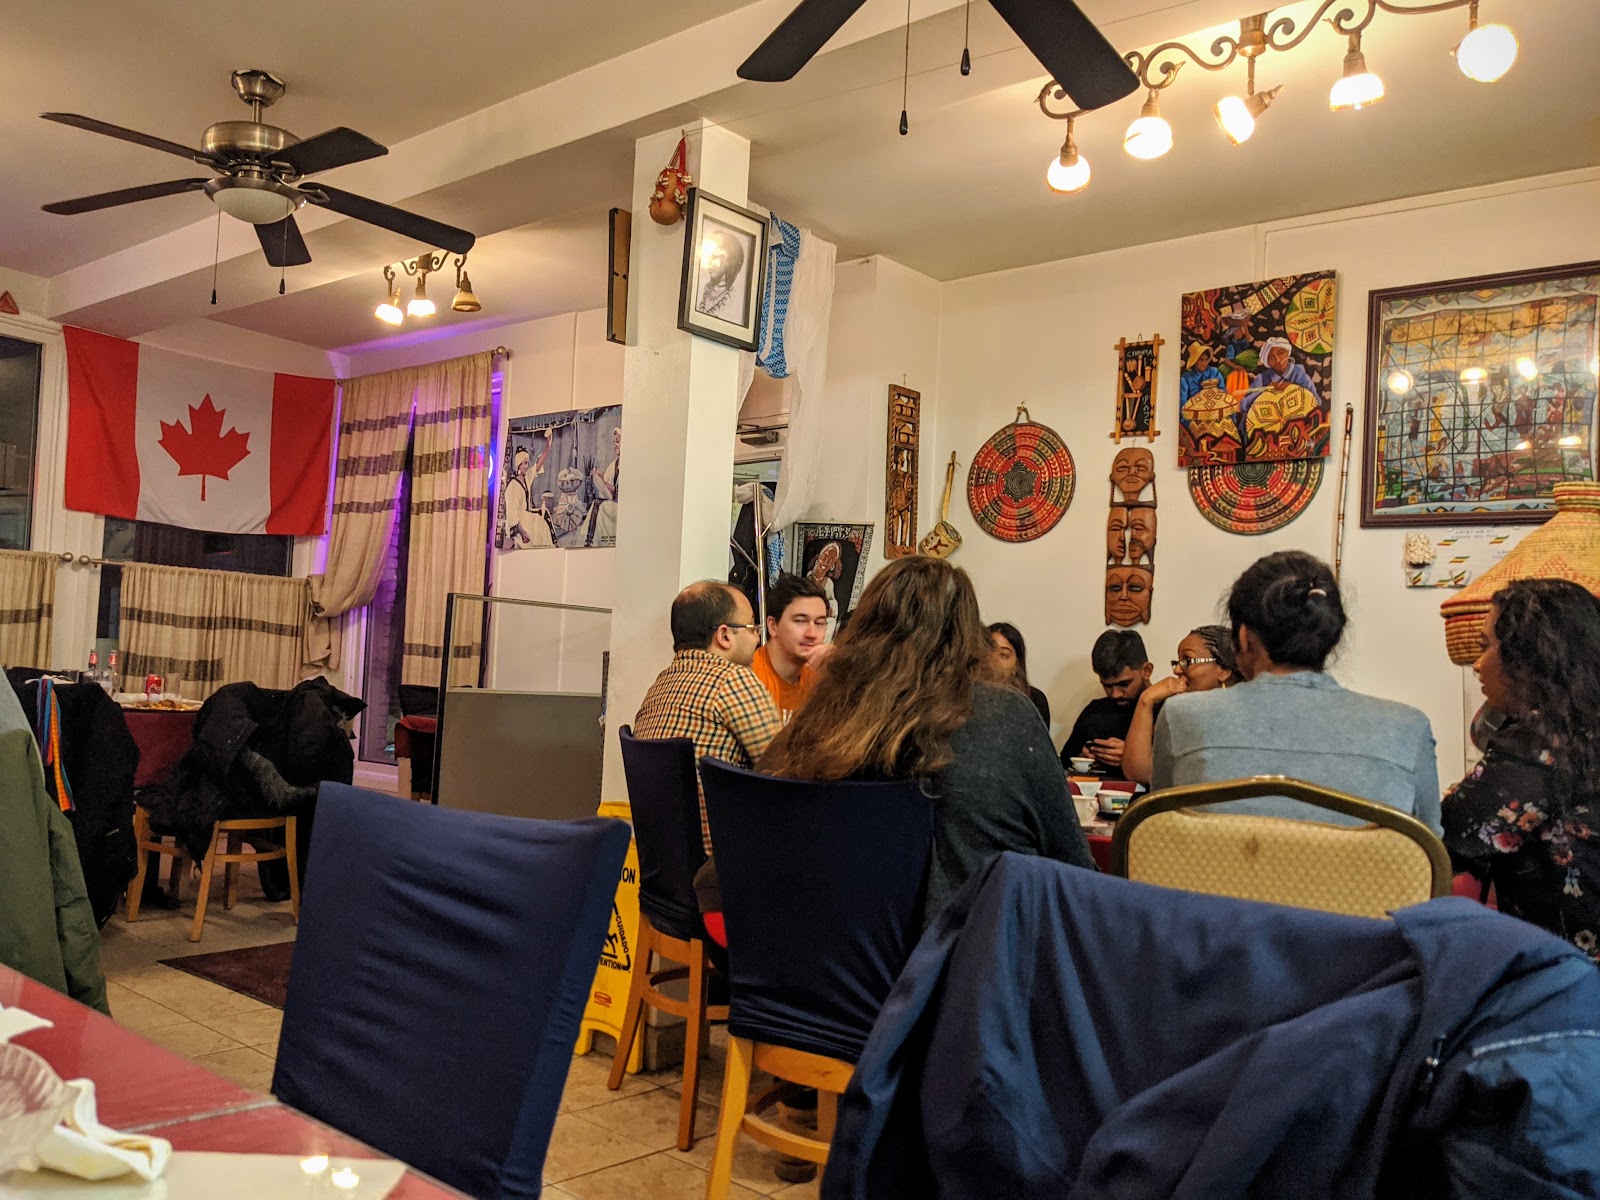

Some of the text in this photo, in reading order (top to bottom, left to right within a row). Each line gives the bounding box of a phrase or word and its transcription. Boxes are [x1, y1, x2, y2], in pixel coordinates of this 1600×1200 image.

[622, 867, 635, 884] ON
[616, 916, 629, 953] CUIDADO
[600, 957, 621, 970] ENTION
